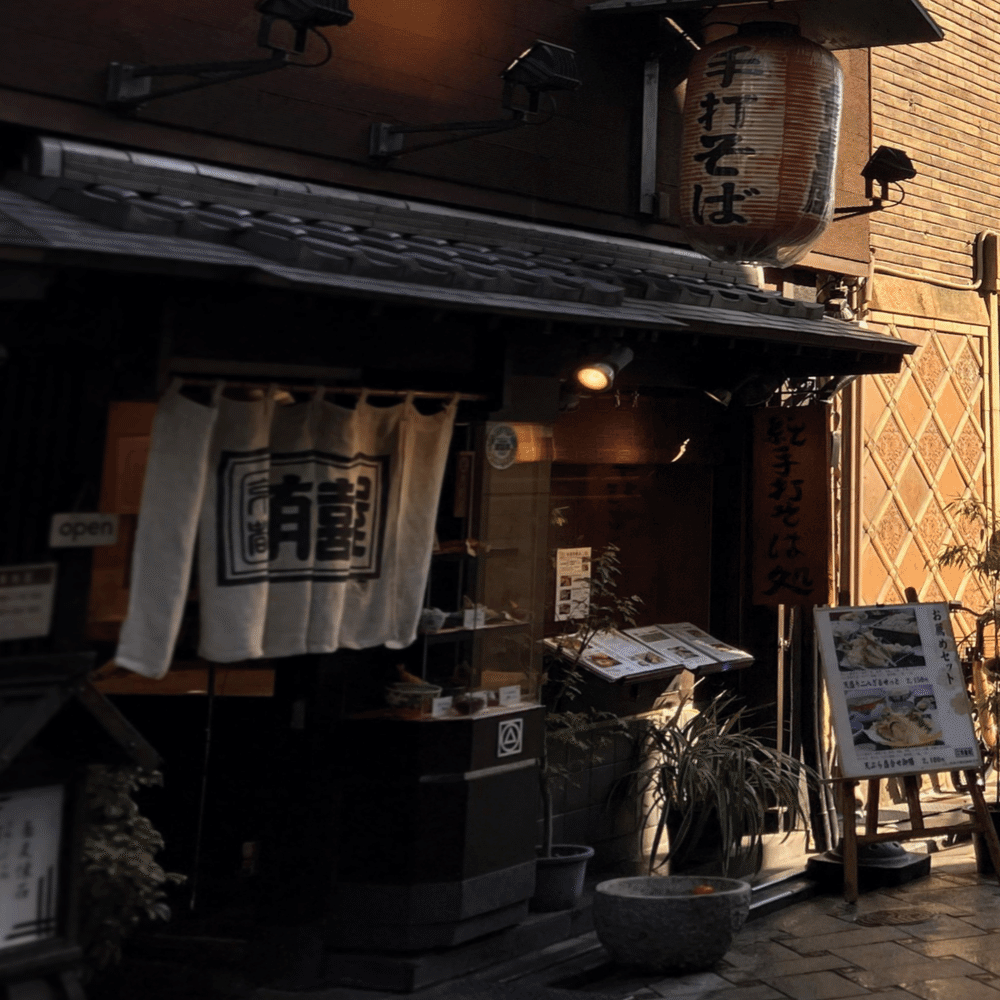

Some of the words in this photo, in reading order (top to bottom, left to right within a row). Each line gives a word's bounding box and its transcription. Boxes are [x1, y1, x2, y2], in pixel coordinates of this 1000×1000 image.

[692, 44, 764, 226] 手打そば
[59, 517, 114, 540] open
